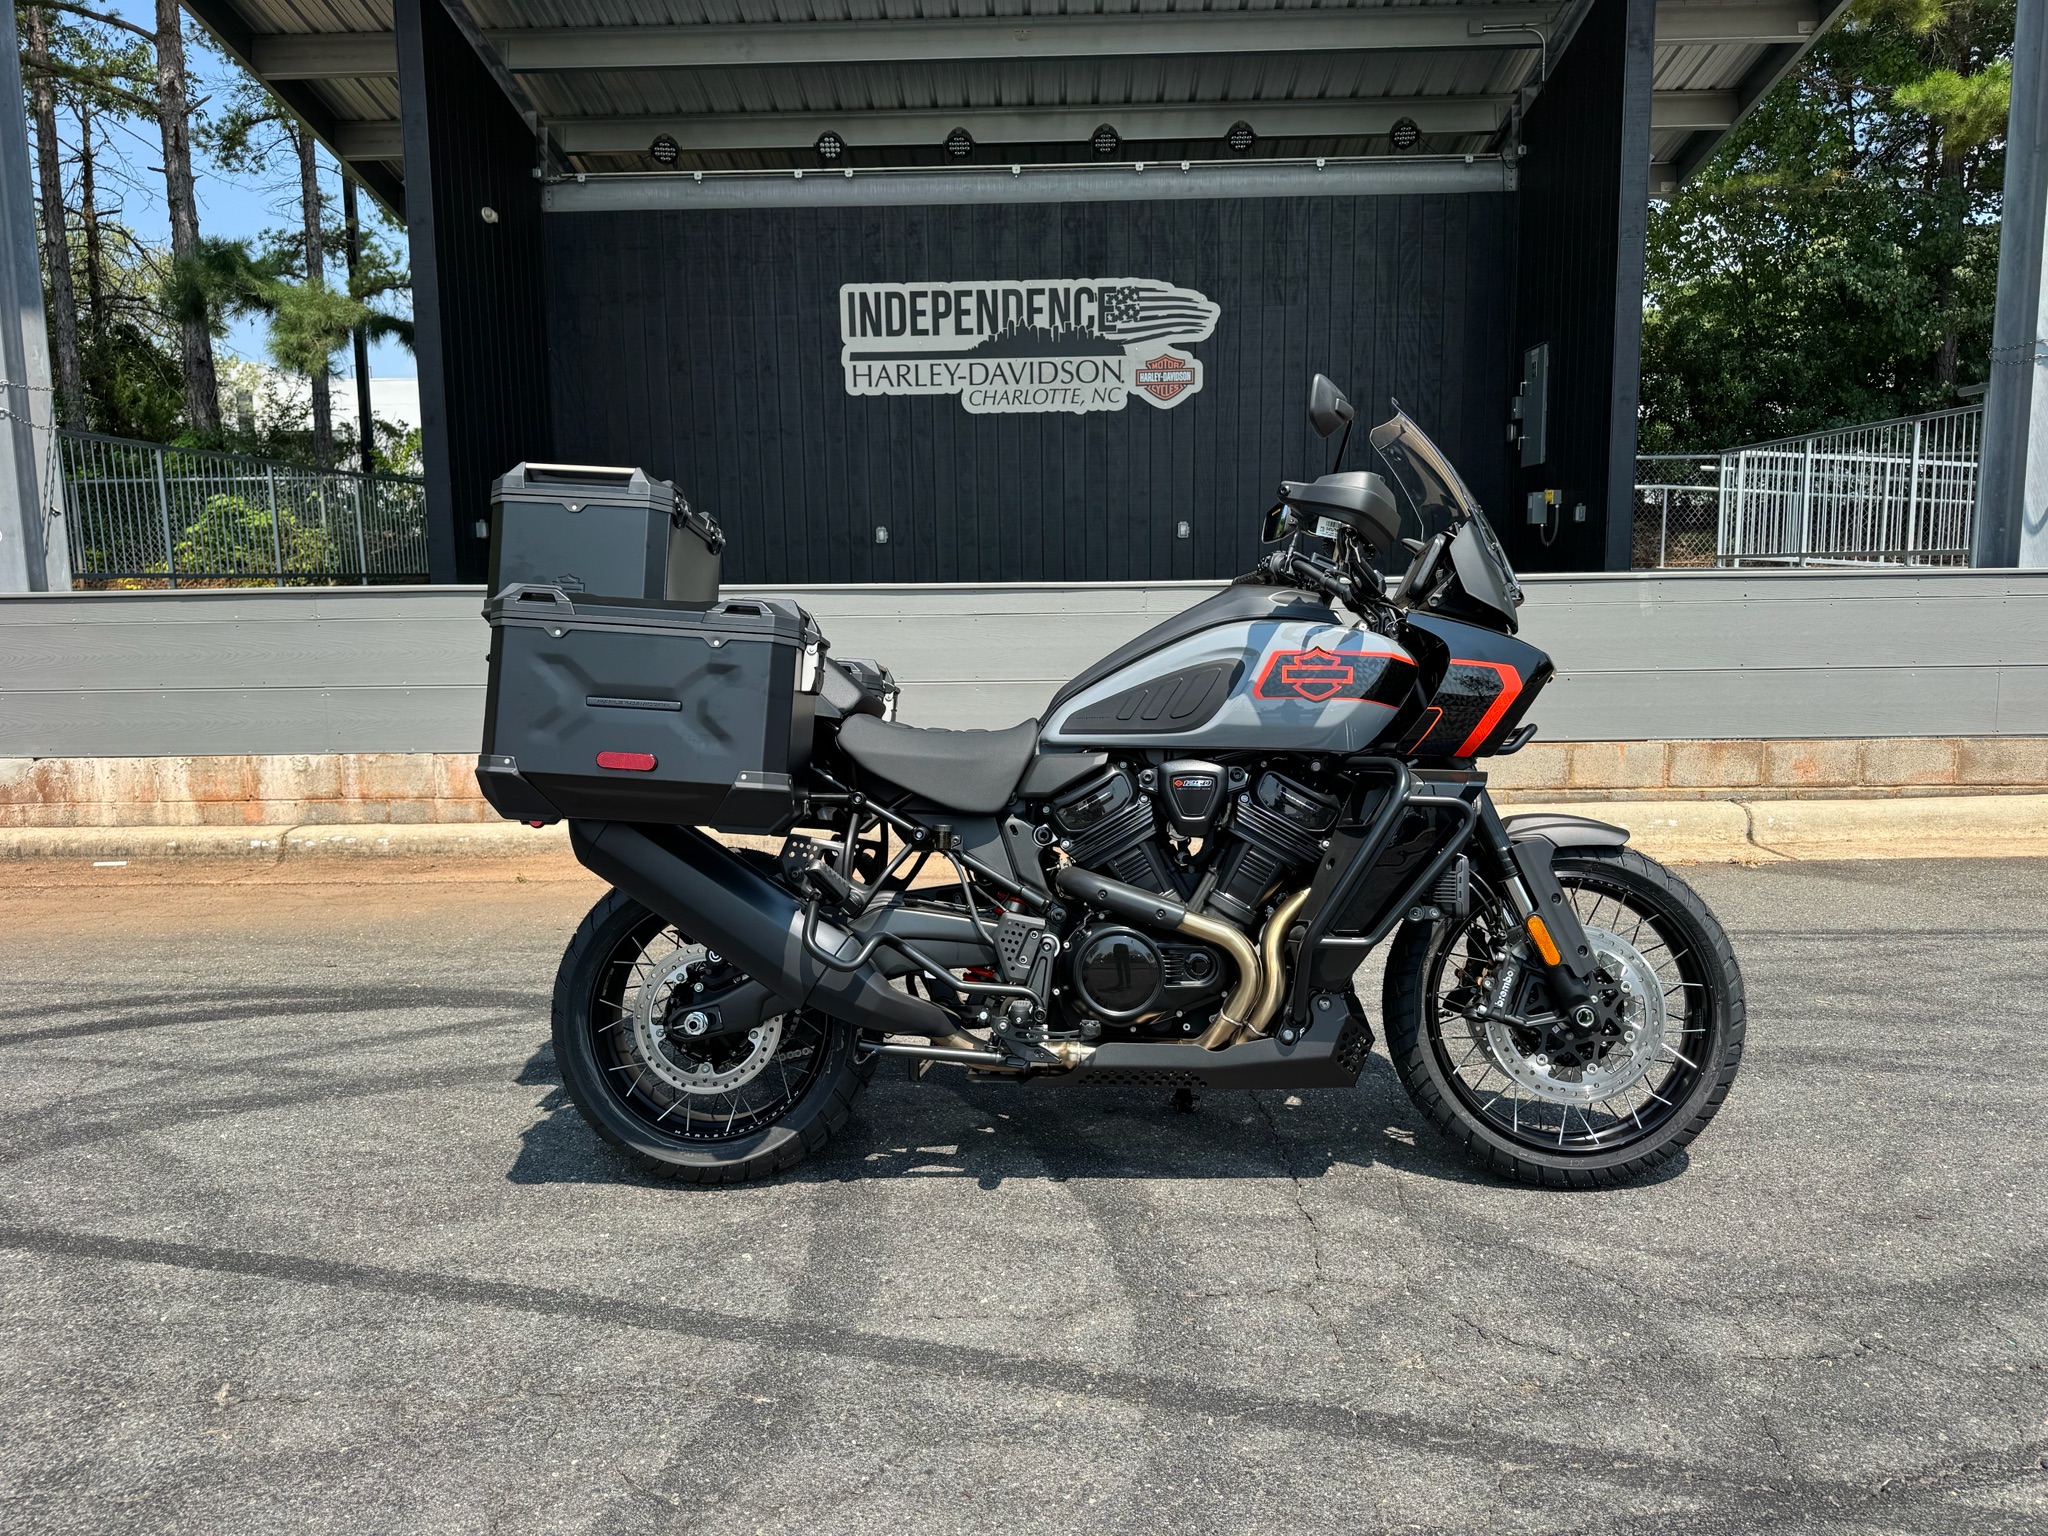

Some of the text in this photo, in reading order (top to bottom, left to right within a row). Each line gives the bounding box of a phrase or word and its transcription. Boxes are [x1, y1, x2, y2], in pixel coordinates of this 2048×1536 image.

[1151, 360, 1179, 369] MOTOR
[1139, 371, 1191, 382] HARLEY-DAVIDSON
[969, 387, 1121, 407] CHARLOTTE, NC
[1151, 384, 1179, 397] CYCLES
[1475, 691, 1511, 741] 1250
[1495, 970, 1514, 1008] brembo
[674, 1090, 799, 1138] HARLEY-DAVIDSON
